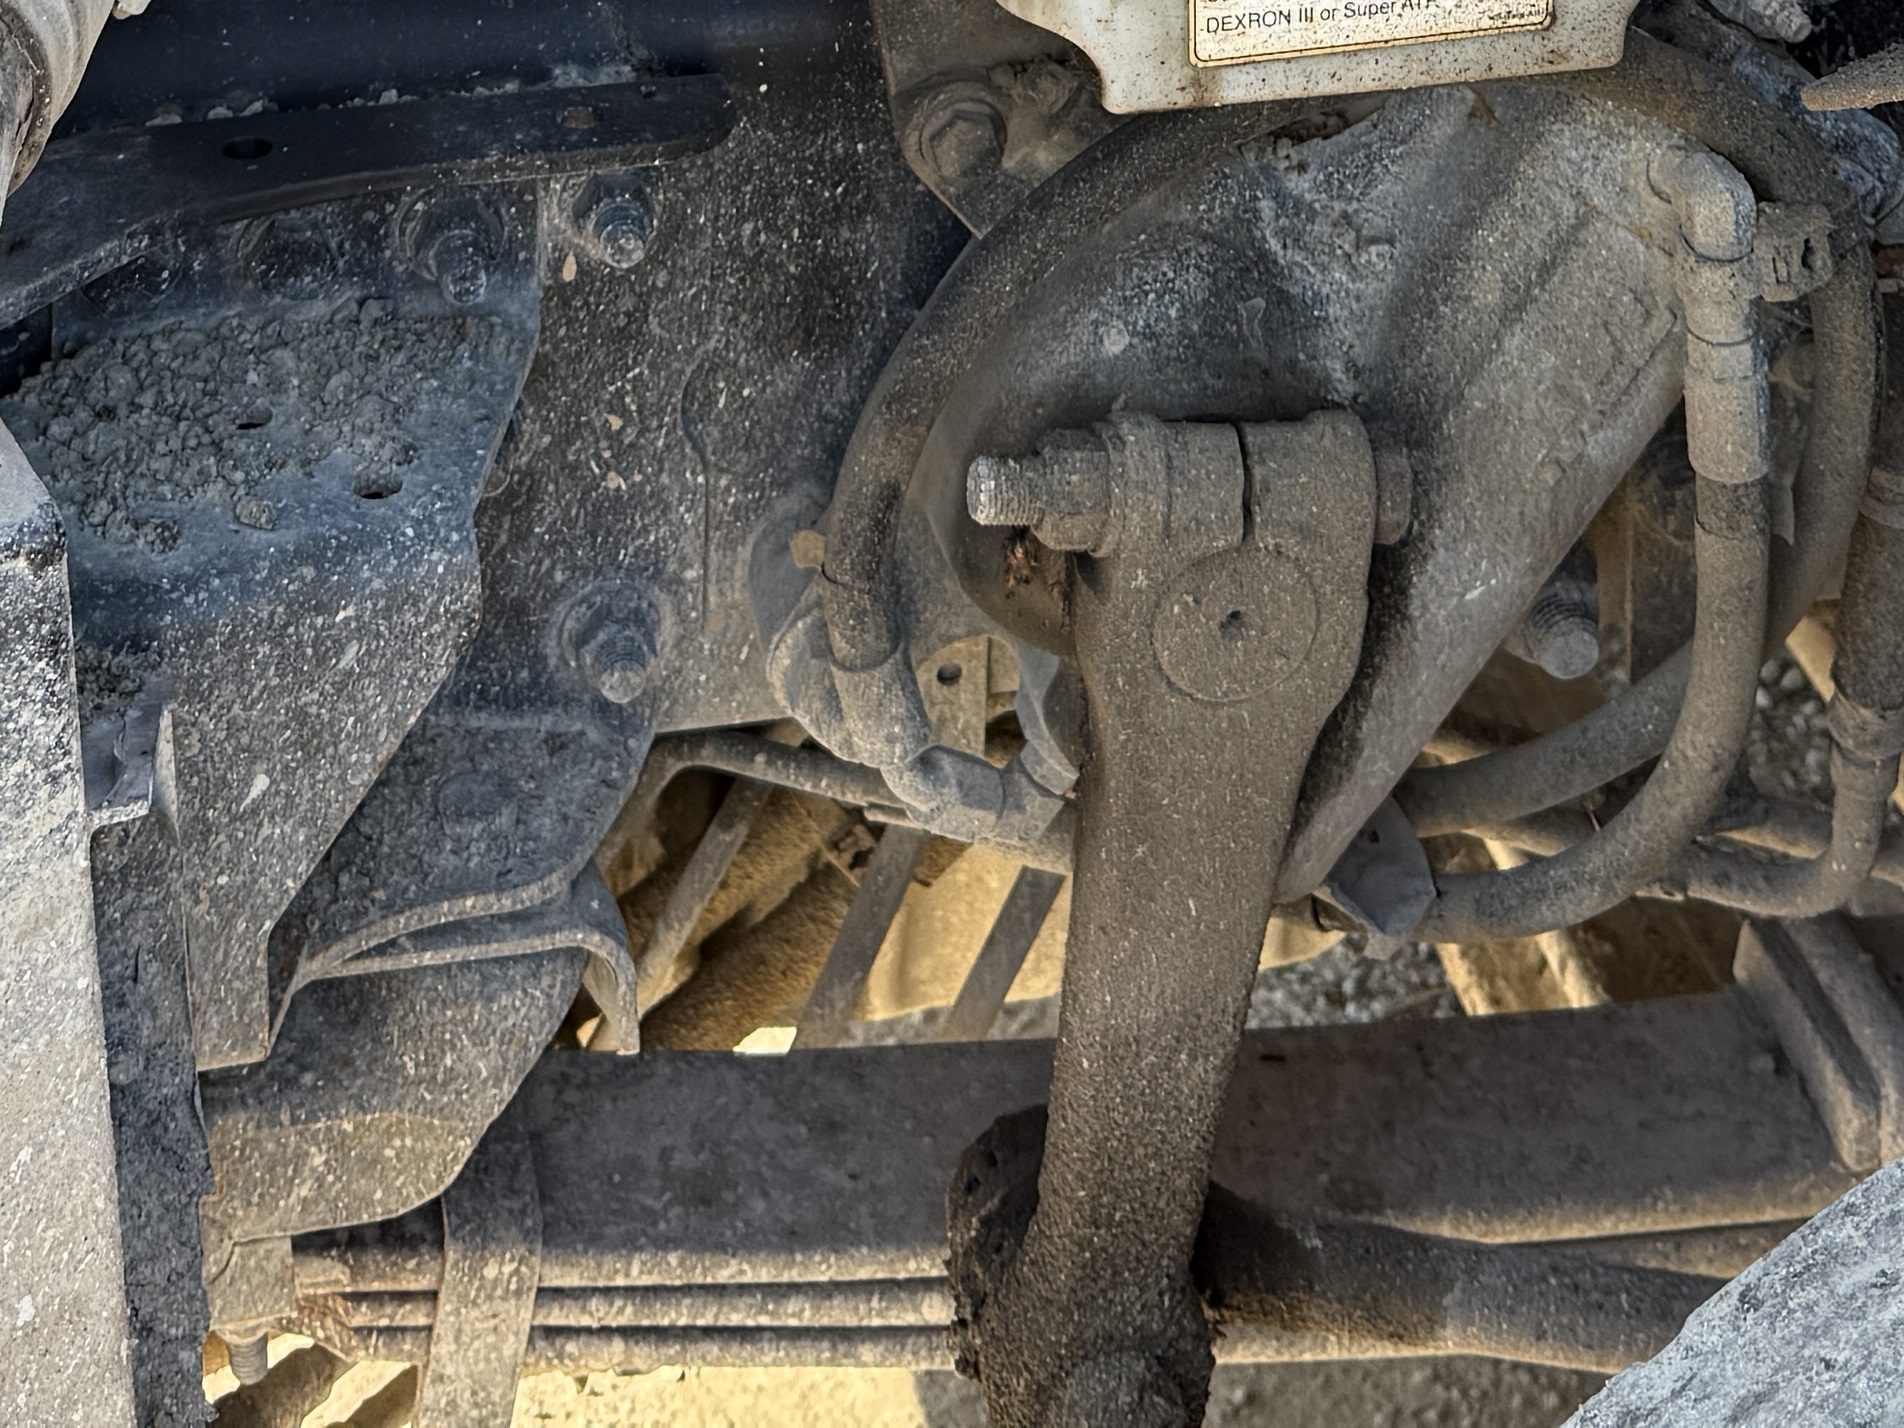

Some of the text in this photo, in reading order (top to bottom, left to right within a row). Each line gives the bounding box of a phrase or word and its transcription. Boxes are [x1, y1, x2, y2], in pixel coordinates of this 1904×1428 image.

[1205, 11, 1292, 35] DEXRON
[1319, 7, 1340, 22] or
[1344, 0, 1397, 20] Super
